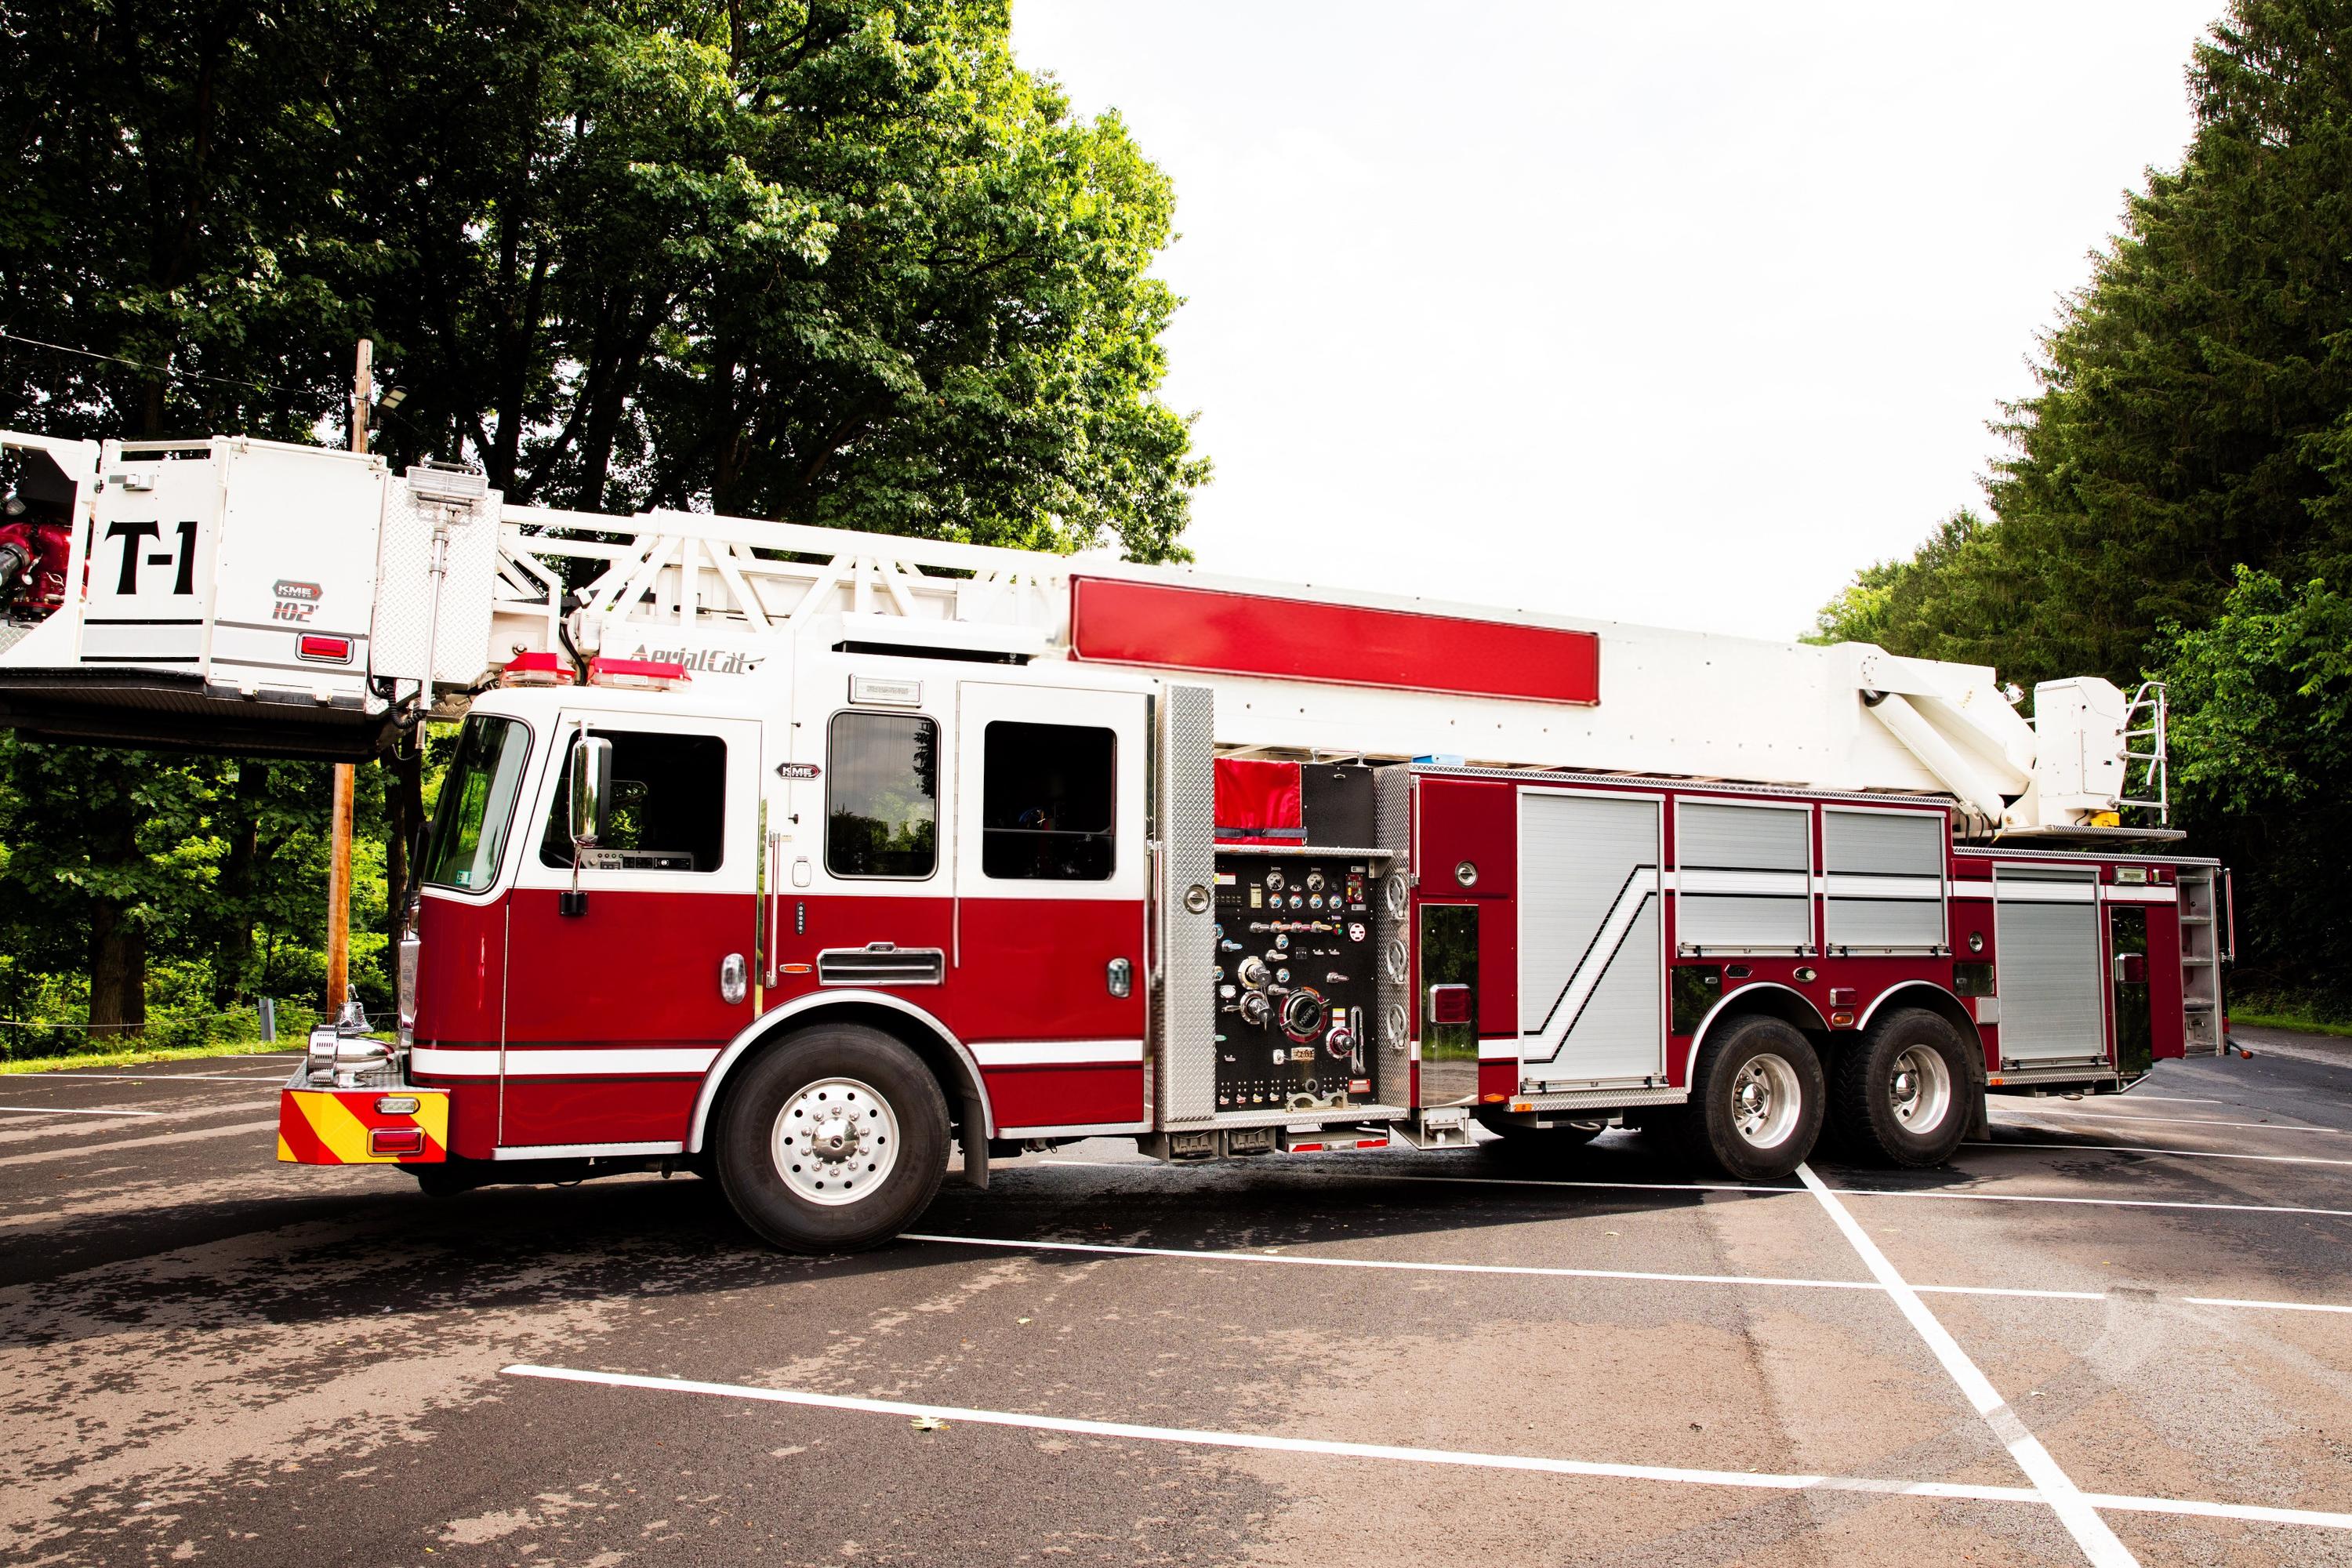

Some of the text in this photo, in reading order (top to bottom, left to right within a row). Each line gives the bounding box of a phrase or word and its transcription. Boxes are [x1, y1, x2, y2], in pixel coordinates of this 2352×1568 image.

[104, 520, 198, 594] T-1
[278, 585, 311, 595] KME
[630, 644, 765, 674] AerialCat
[782, 766, 812, 775] KME
